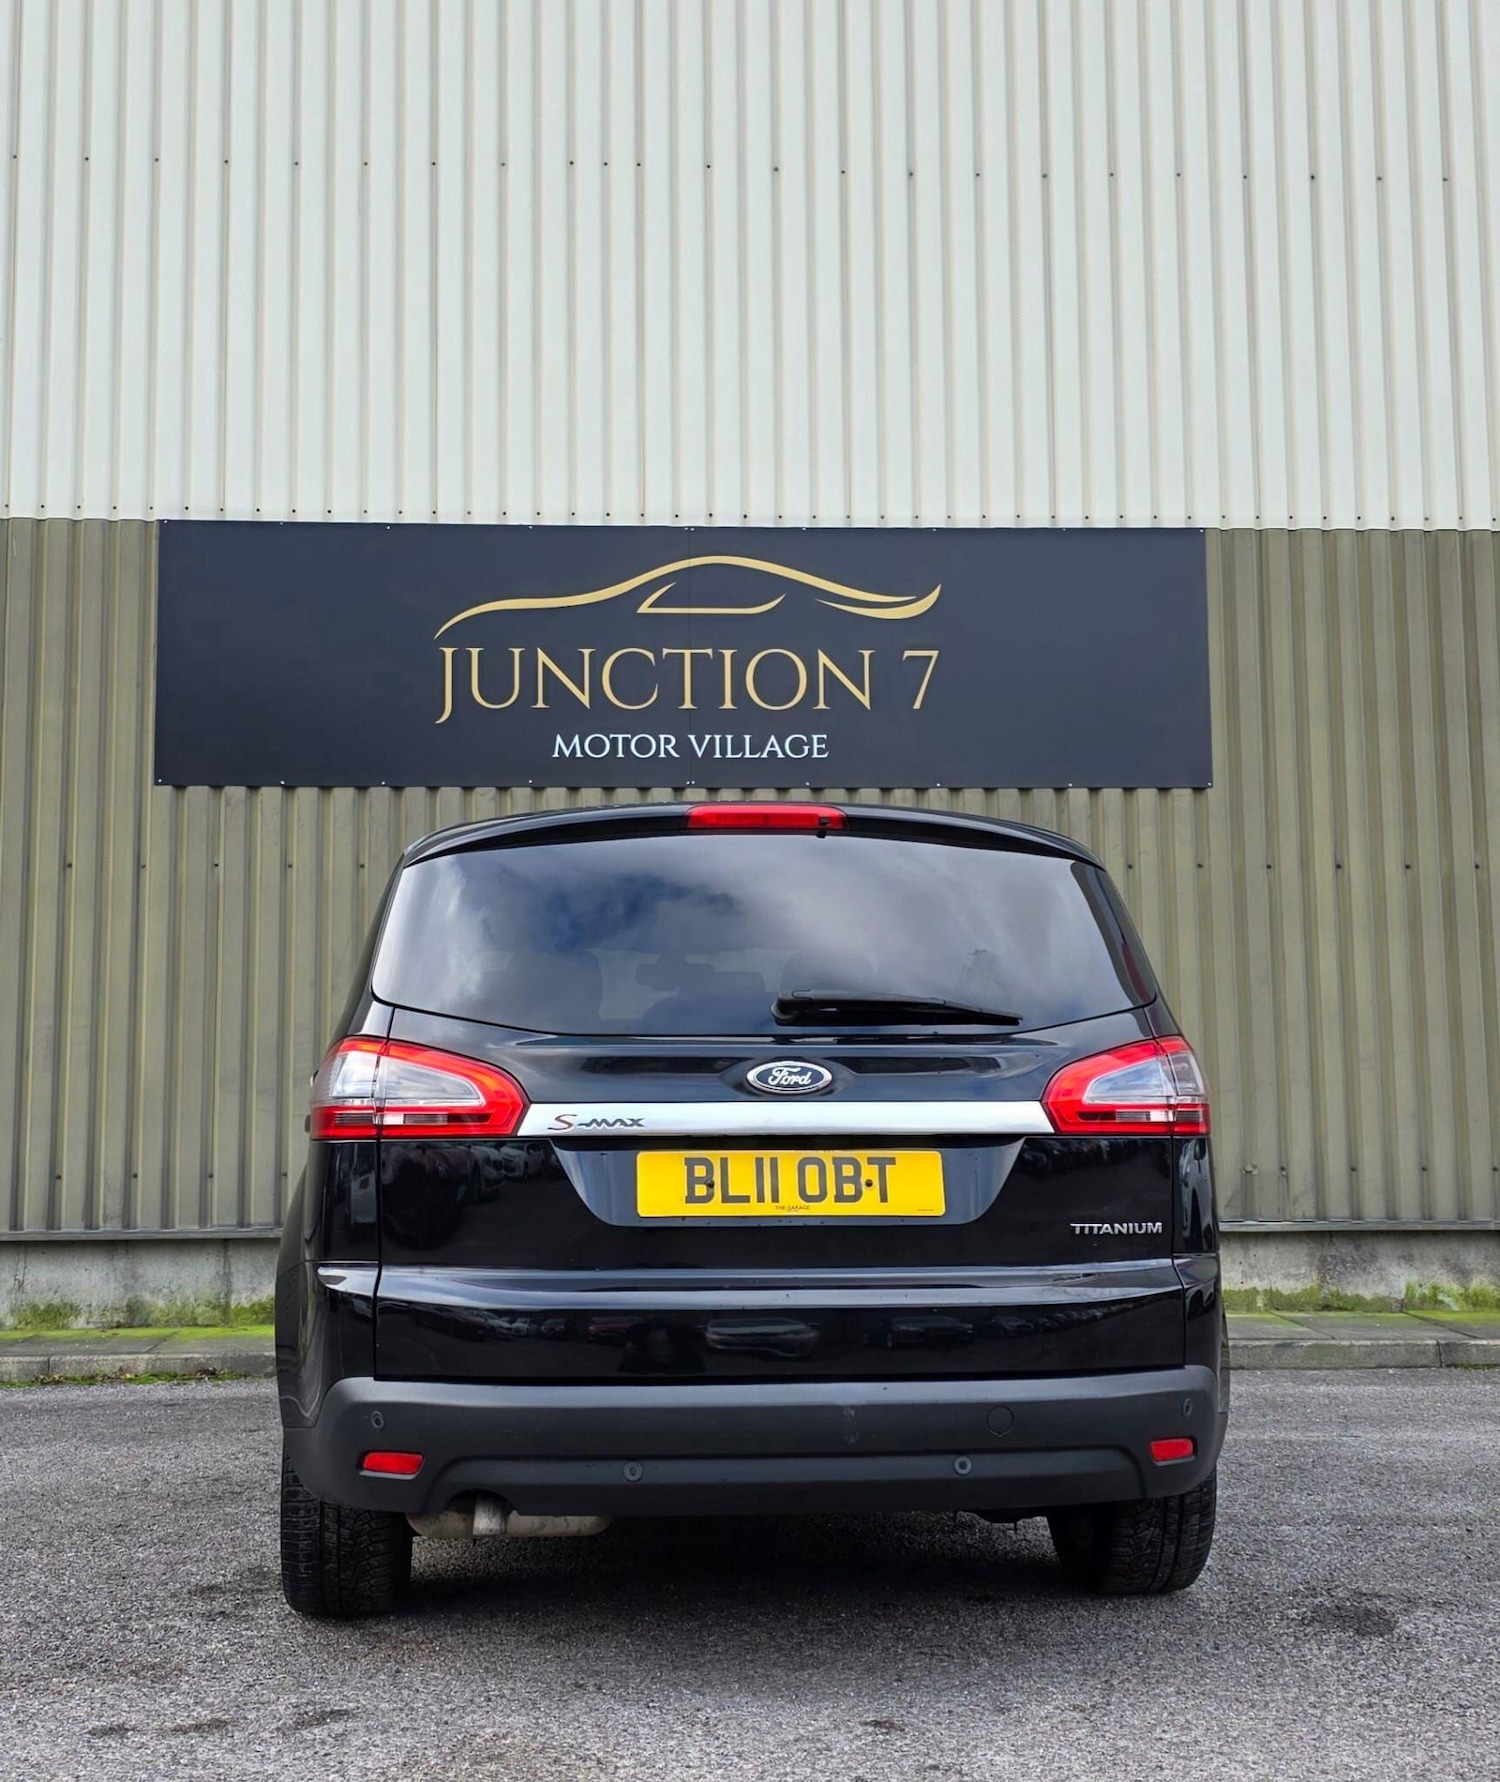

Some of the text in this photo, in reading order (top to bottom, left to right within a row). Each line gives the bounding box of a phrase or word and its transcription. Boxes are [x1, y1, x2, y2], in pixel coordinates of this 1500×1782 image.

[435, 647, 939, 724] JUNCTION 7
[552, 734, 829, 759] MOTOR VILLAGE
[768, 1067, 812, 1085] Ford
[547, 1114, 645, 1130] S-MAX
[684, 1157, 896, 1204] BL11 OBT
[1070, 1222, 1162, 1234] TITANIUM
